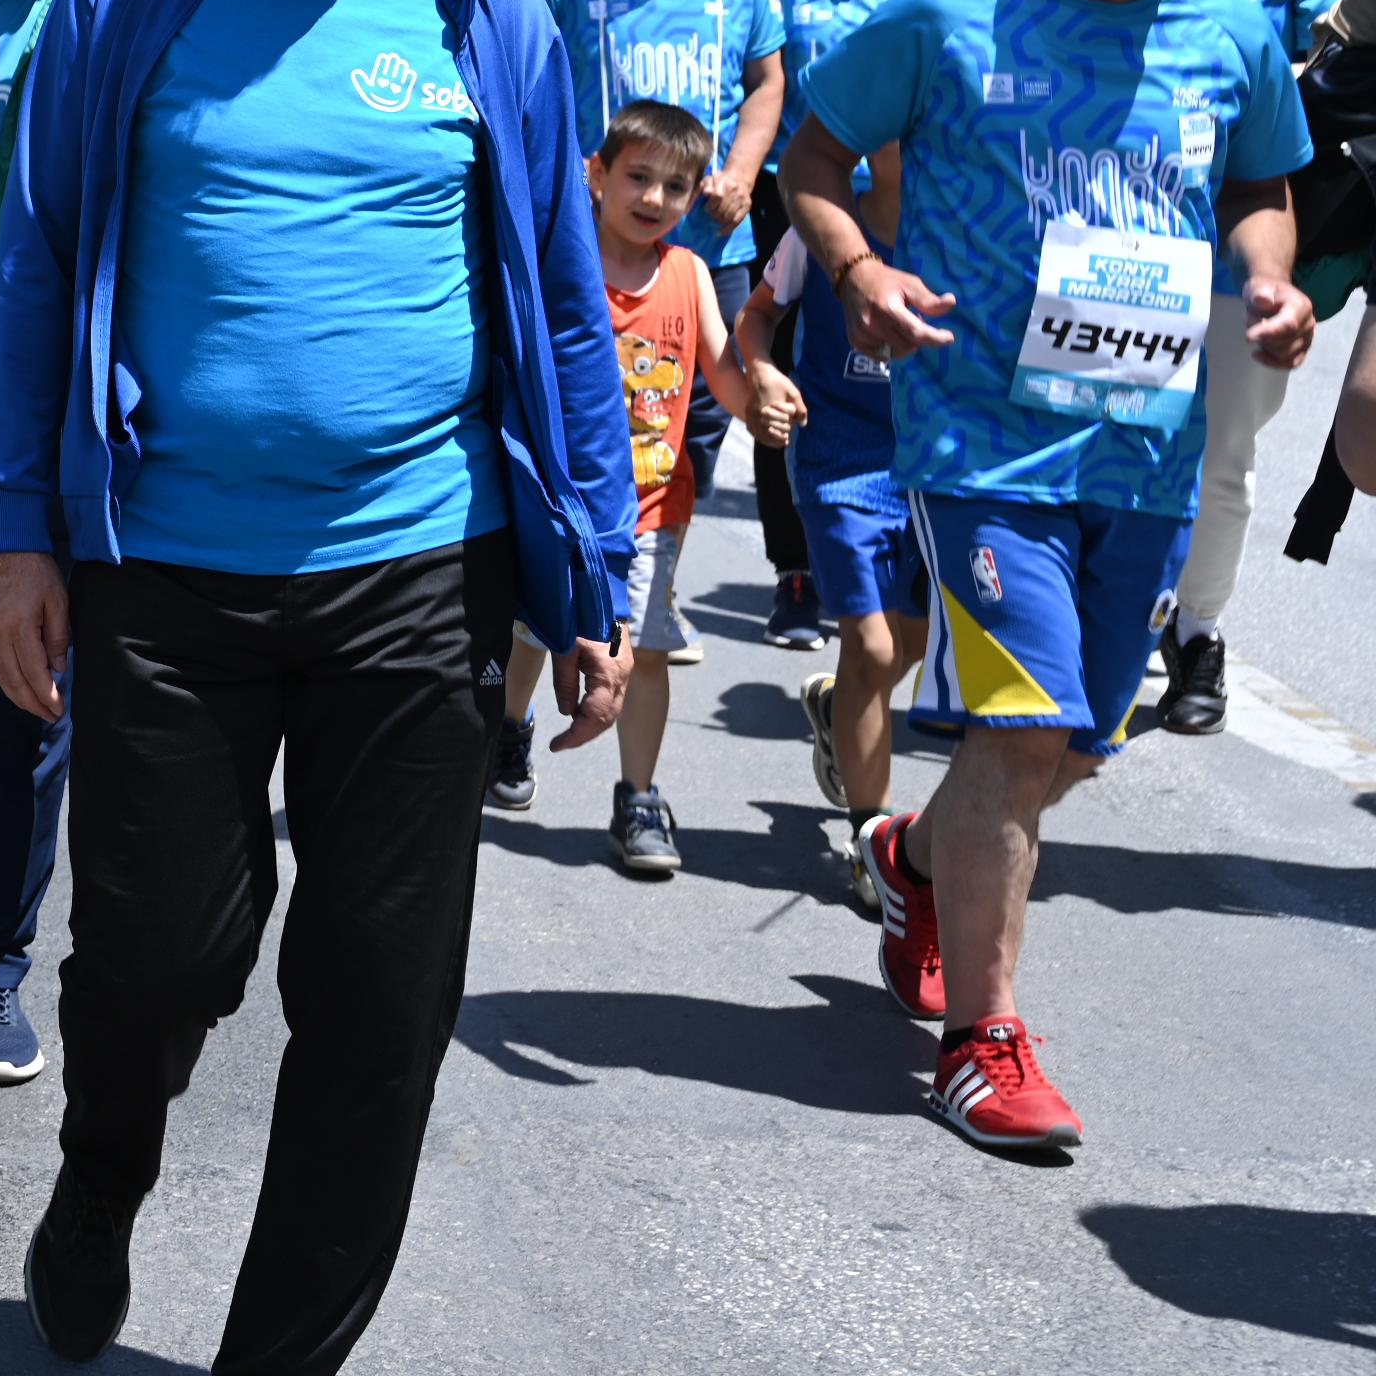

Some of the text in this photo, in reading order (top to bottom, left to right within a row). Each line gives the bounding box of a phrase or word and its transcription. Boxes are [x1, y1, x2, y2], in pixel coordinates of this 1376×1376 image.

[1094, 257, 1164, 280] KONYA
[1105, 273, 1153, 293] YARI
[1066, 280, 1184, 310] MARATONU
[662, 316, 684, 337] LEO
[1040, 316, 1191, 366] 43444
[479, 674, 505, 686] adida
